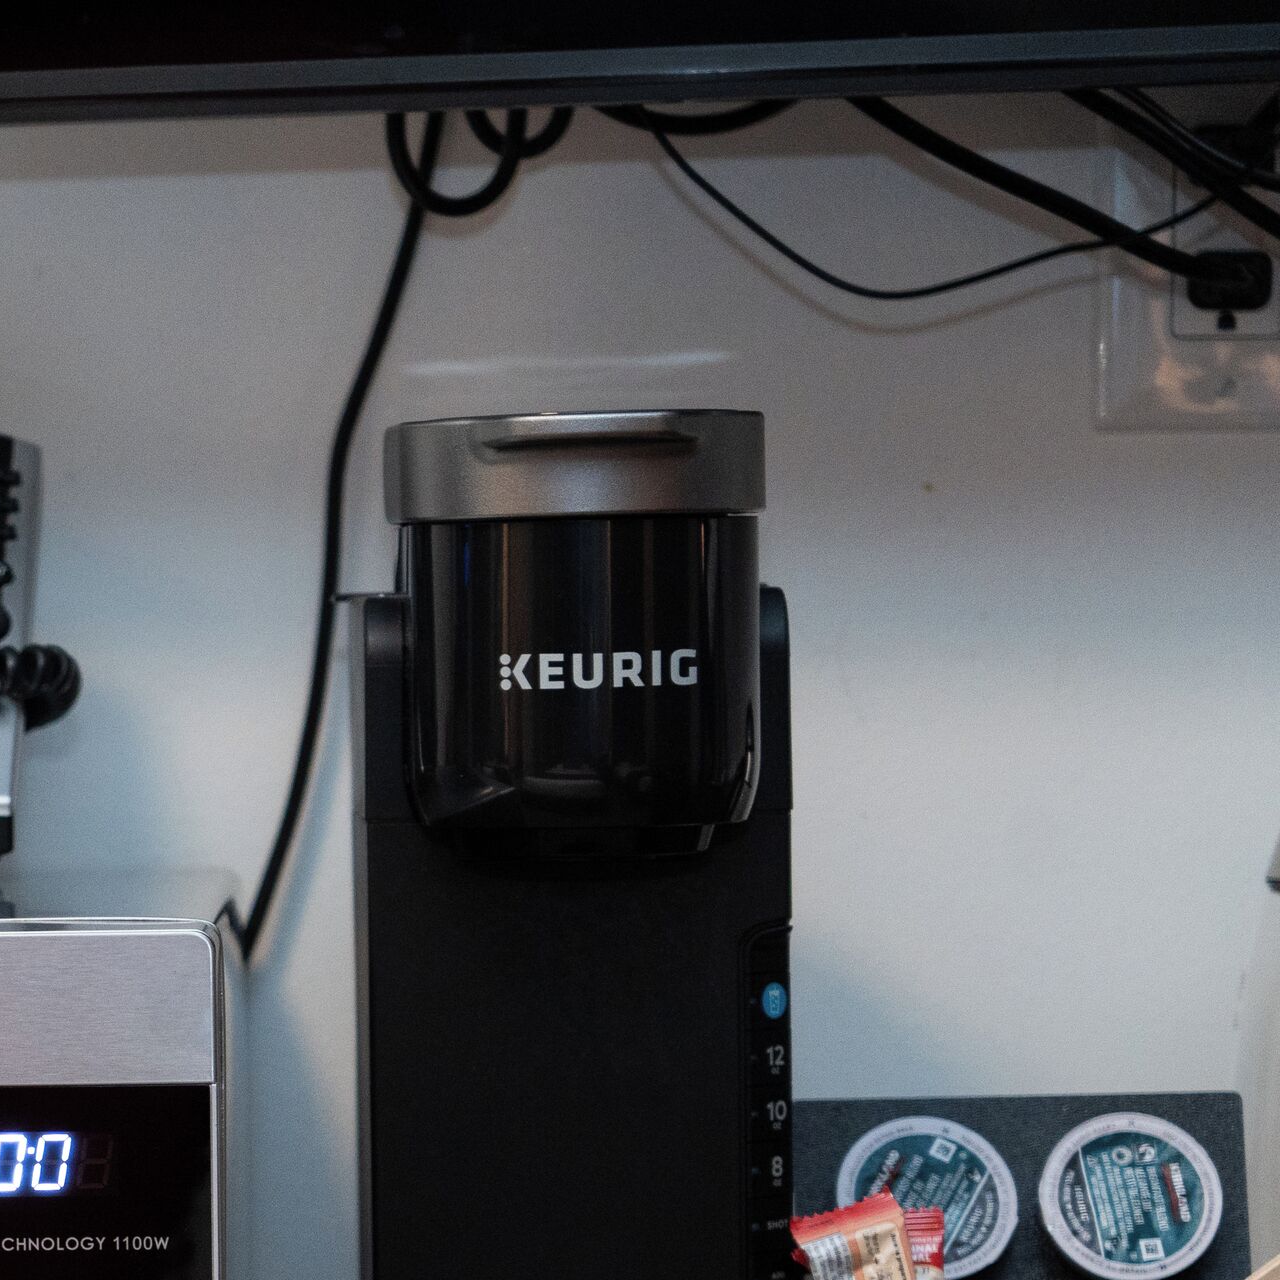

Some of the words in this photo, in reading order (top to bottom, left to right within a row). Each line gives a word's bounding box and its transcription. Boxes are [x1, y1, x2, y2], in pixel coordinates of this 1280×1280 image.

[499, 648, 698, 692] KEURIG
[766, 1045, 785, 1066] 12
[766, 1100, 787, 1121] 10
[771, 1156, 783, 1177] 8
[113, 1236, 170, 1251] 1100W
